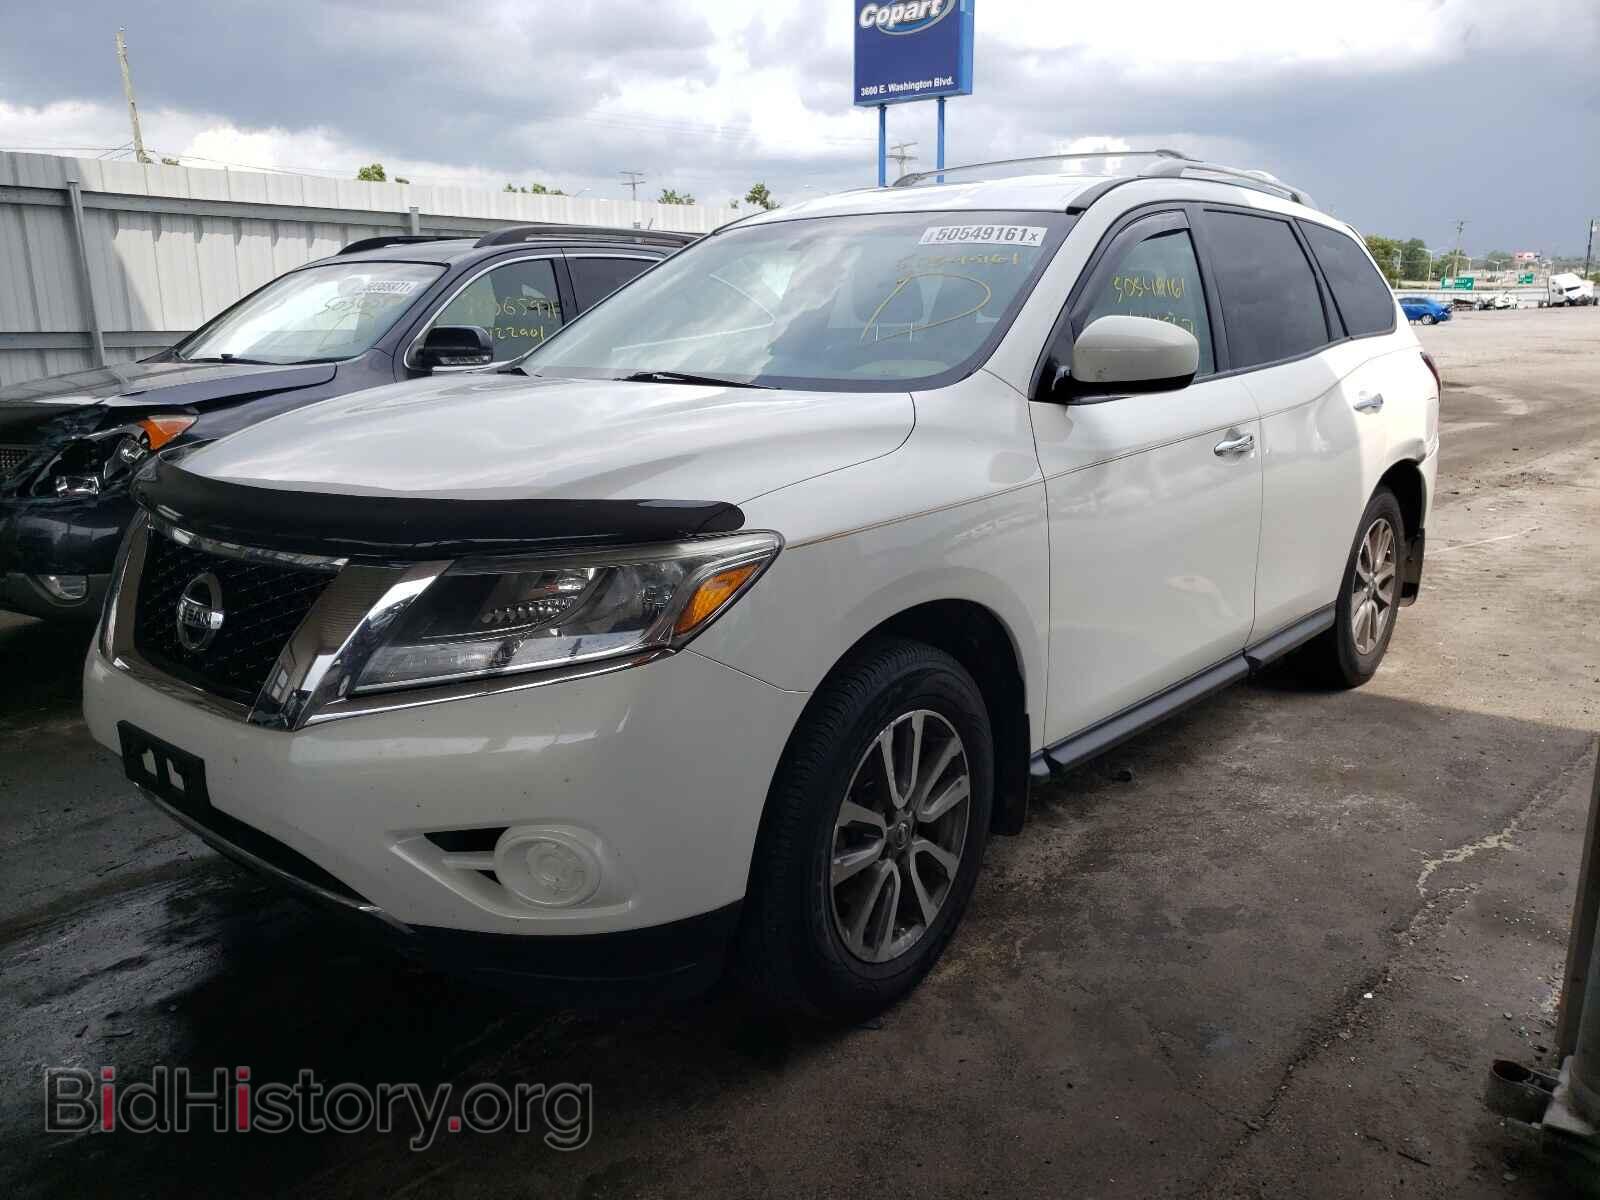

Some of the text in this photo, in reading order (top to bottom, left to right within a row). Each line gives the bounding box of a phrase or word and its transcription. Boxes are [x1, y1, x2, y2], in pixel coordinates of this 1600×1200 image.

[859, 0, 942, 29] Copart
[879, 84, 887, 94] E.
[888, 80, 932, 91] Washington
[933, 76, 954, 87] Blvd.
